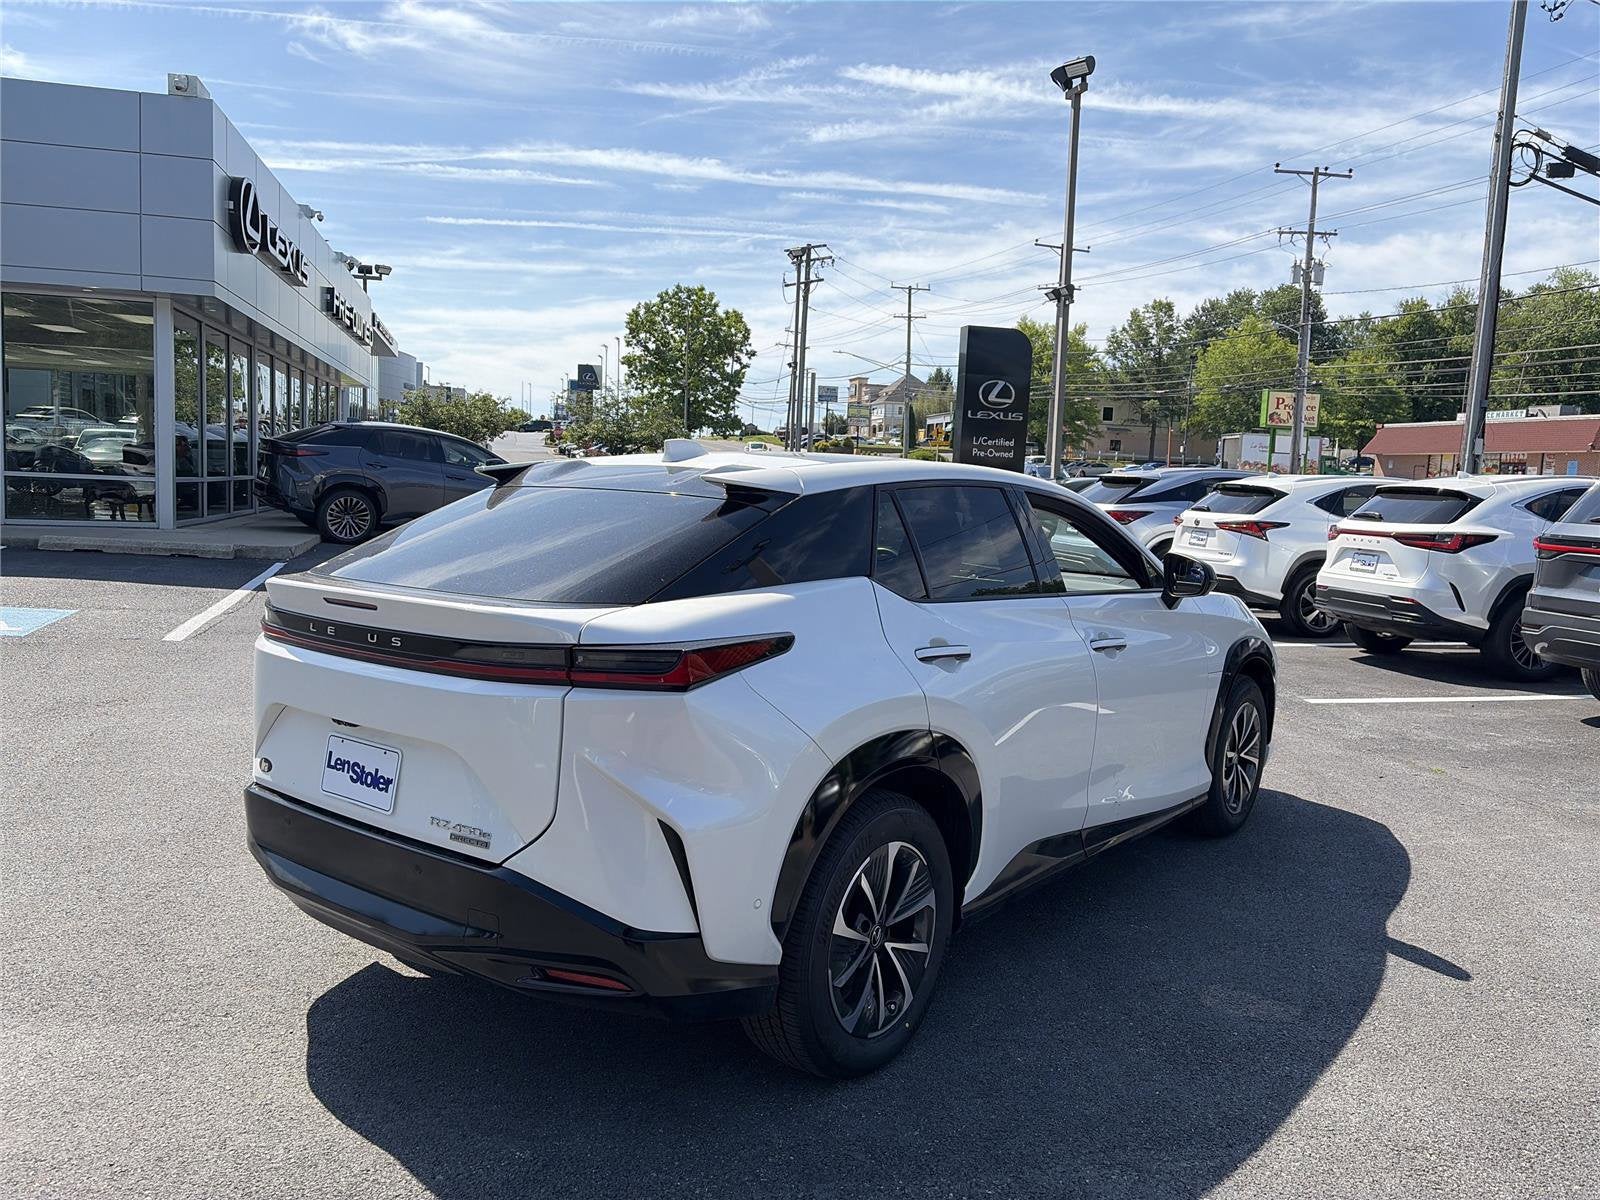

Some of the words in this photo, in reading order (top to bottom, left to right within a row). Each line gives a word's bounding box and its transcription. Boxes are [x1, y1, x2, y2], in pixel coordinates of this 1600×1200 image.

[263, 213, 309, 287] LEXUS
[1275, 396, 1317, 412] Proce
[967, 410, 1024, 421] LEXUS
[972, 436, 1015, 447] L/Certified
[972, 448, 1014, 458] Pre-Owned
[309, 622, 402, 647] LEUS
